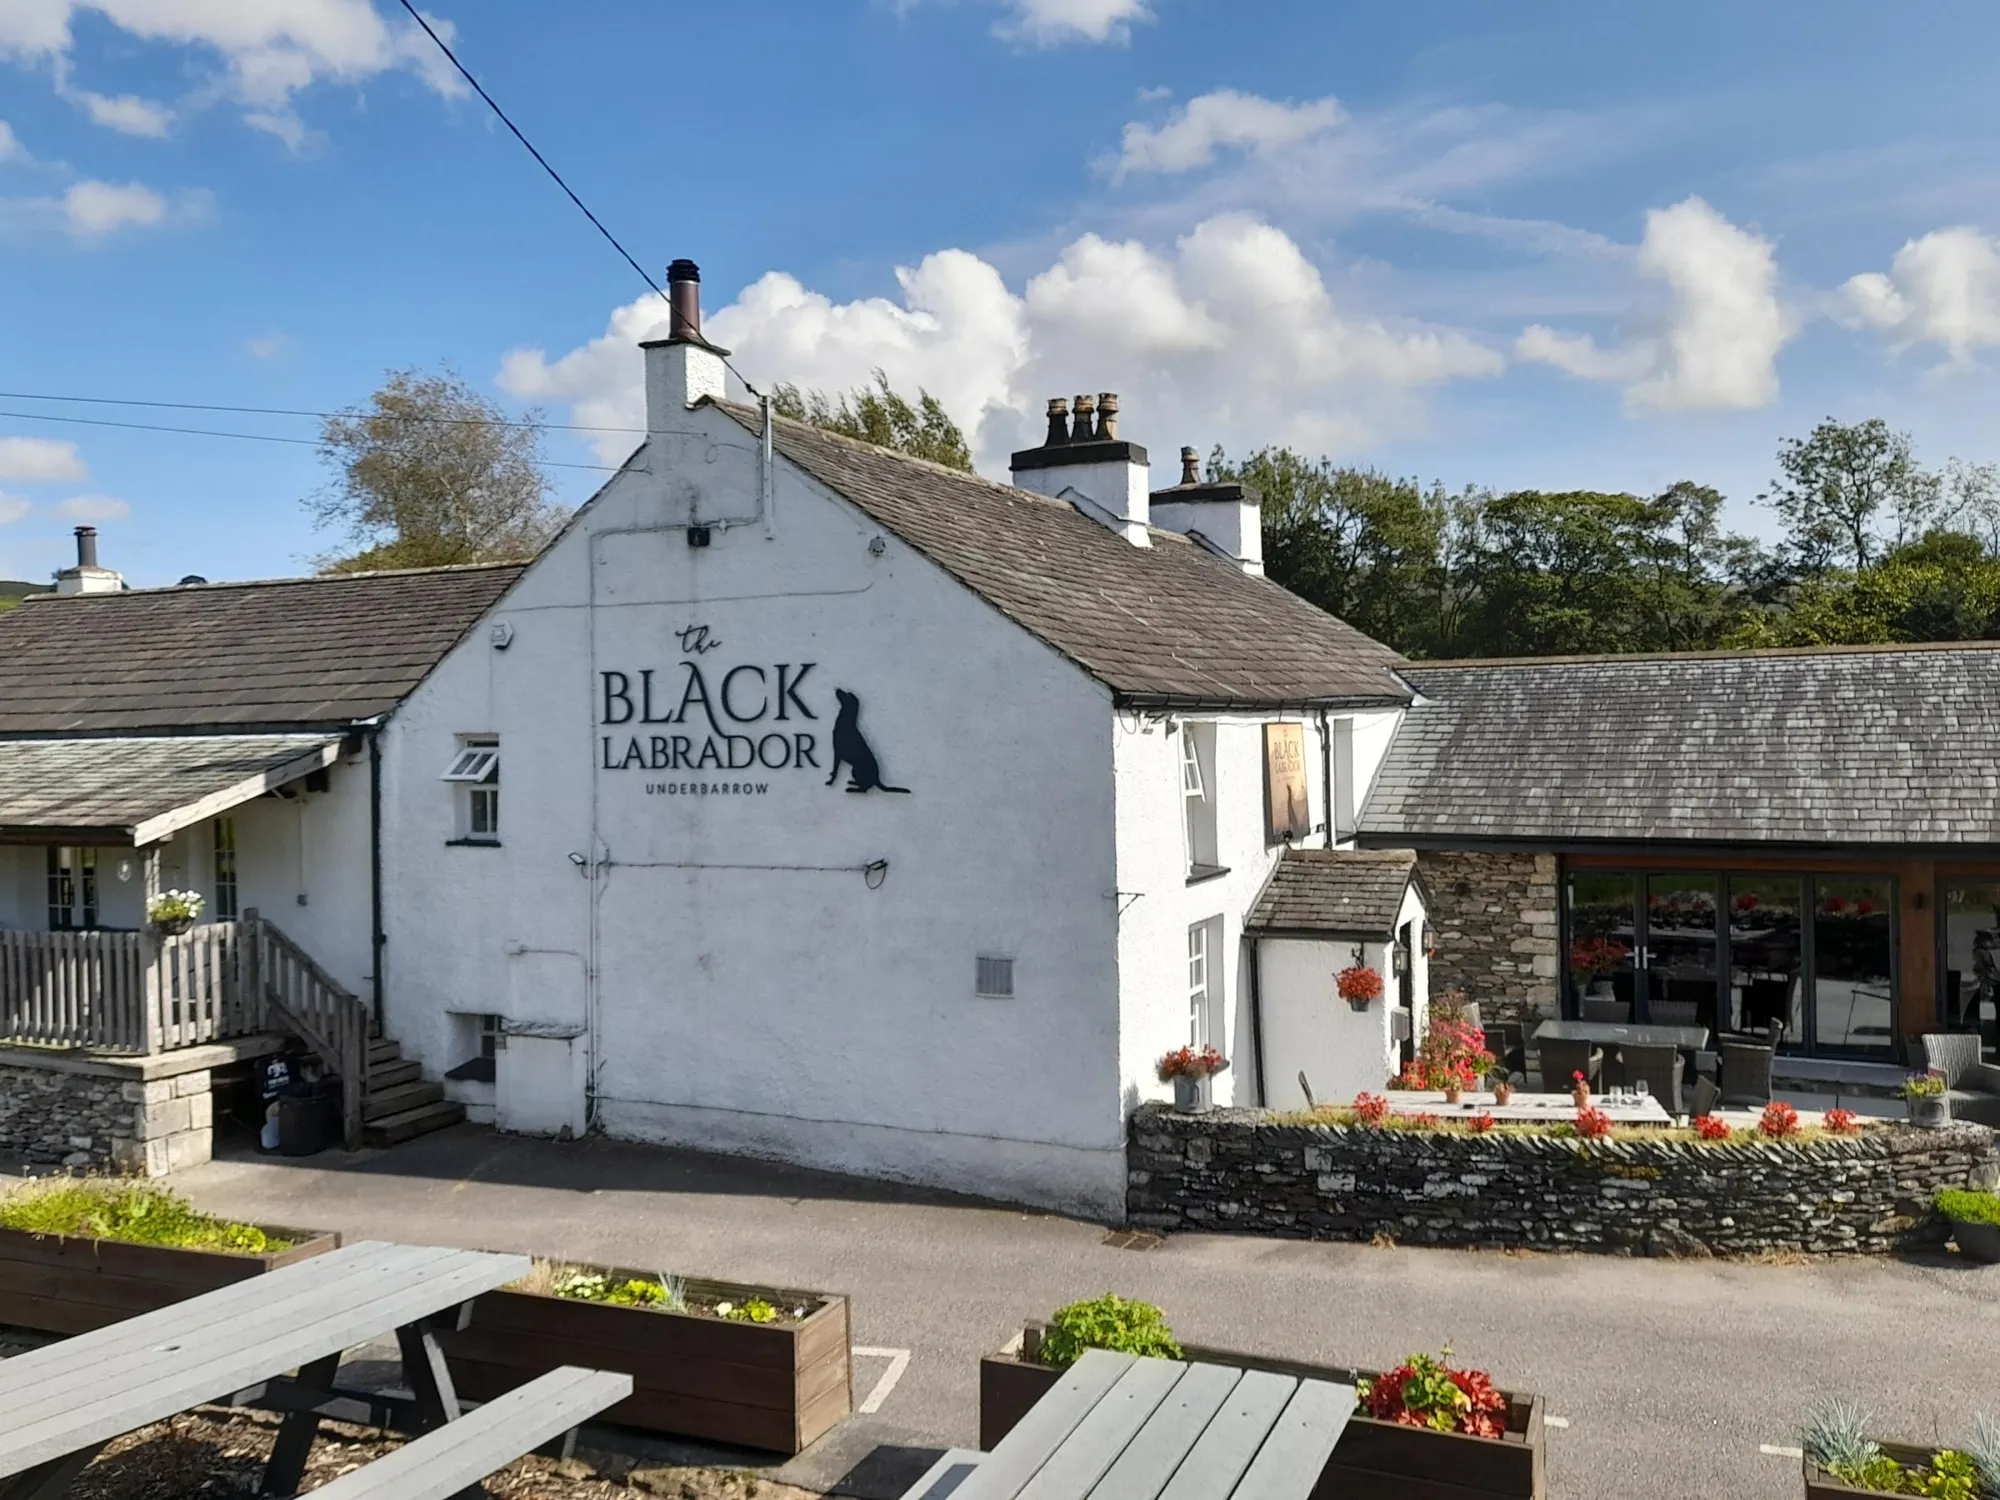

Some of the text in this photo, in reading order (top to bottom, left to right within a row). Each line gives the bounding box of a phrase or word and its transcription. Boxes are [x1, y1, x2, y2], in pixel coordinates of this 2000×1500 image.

[599, 661, 819, 738] BLACK
[602, 733, 820, 770] LABRADOR
[645, 783, 769, 795] UNDERBARROW
